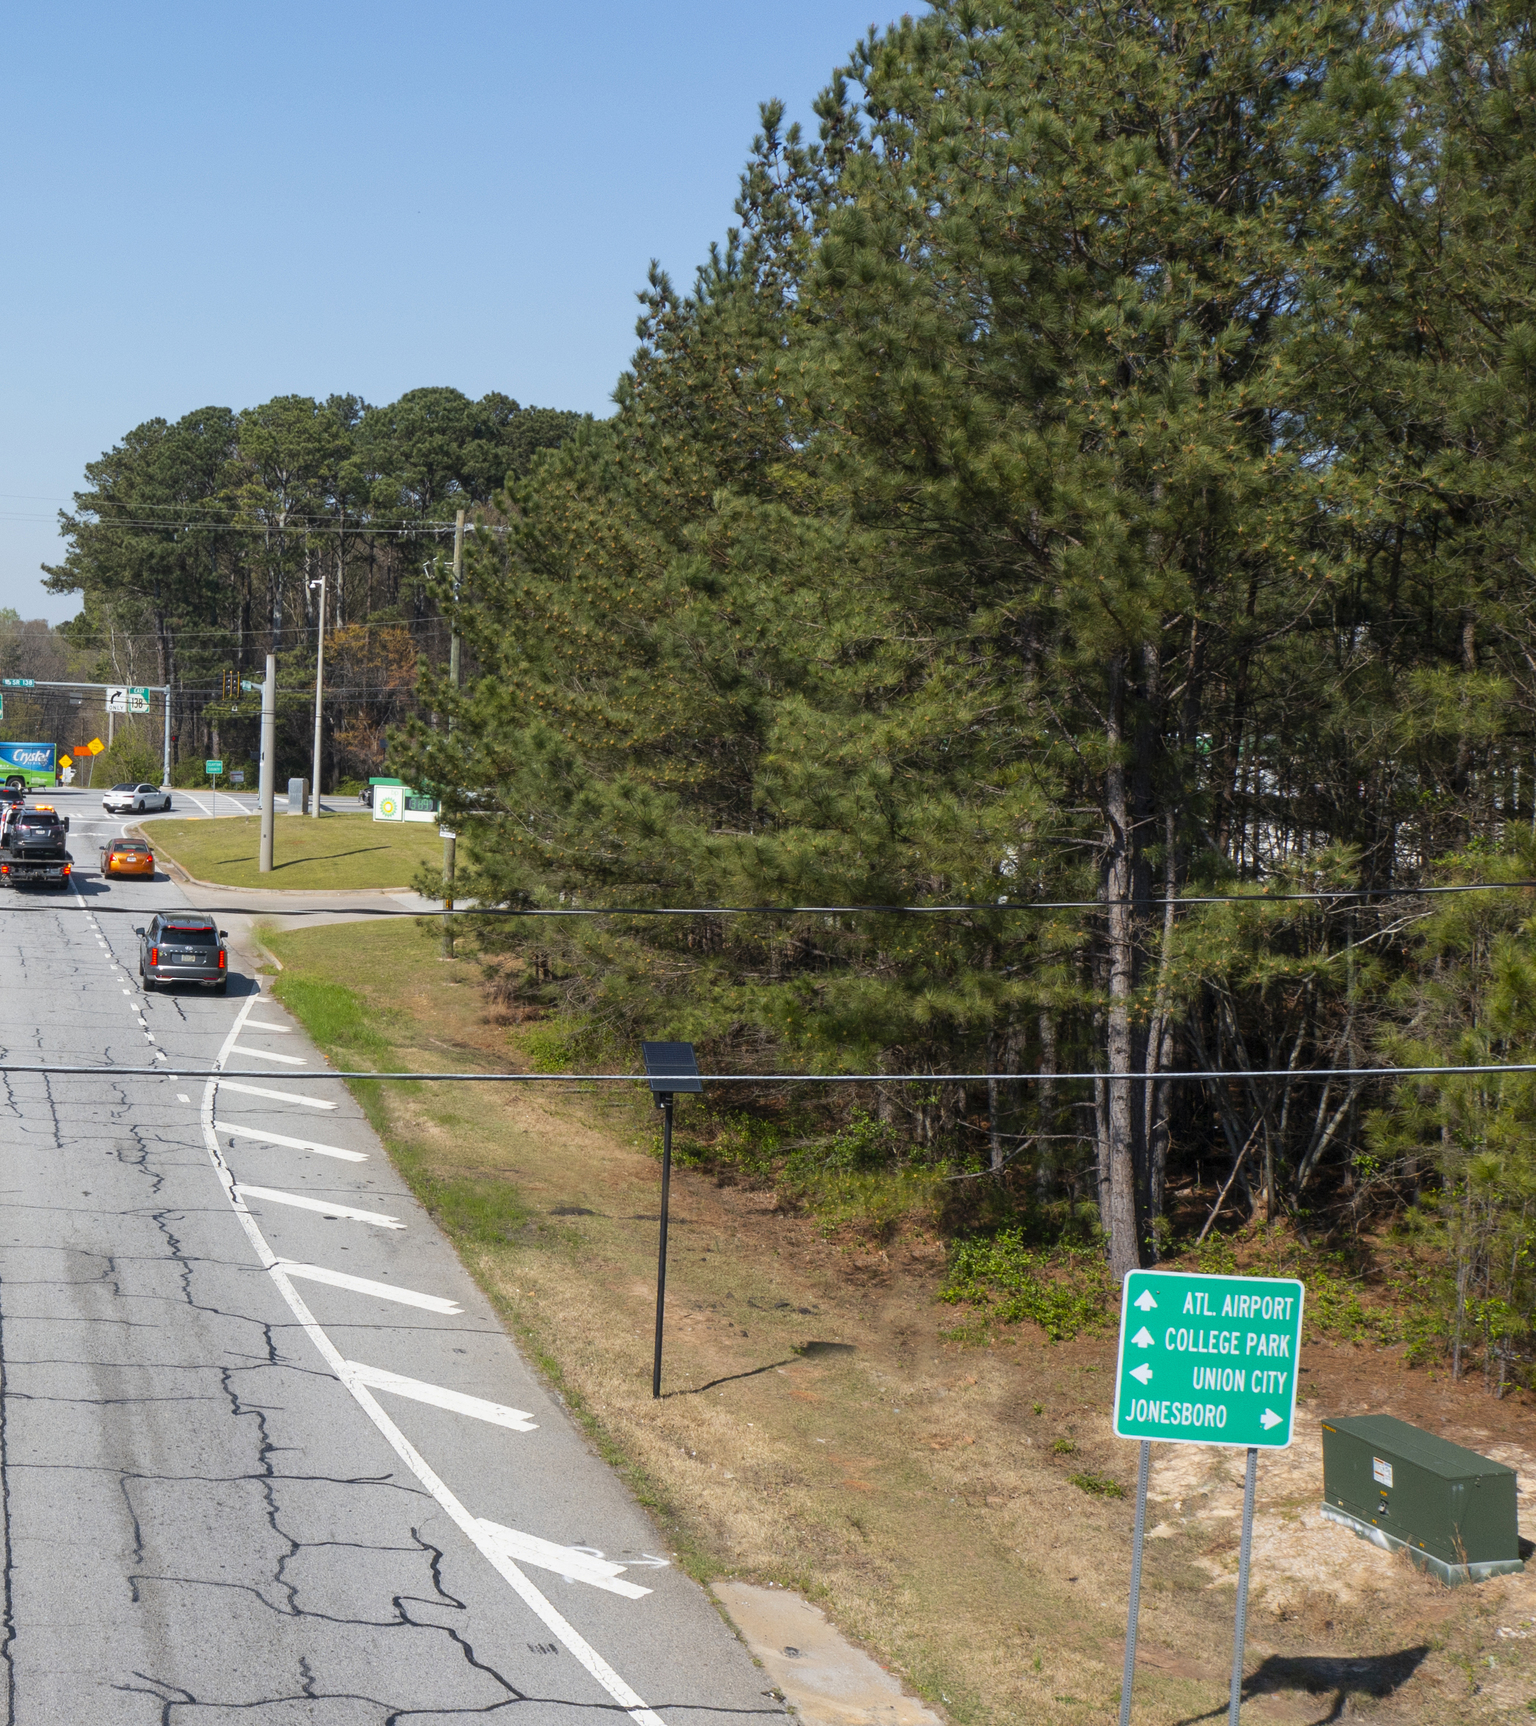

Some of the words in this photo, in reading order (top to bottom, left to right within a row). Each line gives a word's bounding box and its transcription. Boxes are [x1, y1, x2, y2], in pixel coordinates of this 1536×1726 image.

[132, 698, 143, 708] 138
[1182, 1292, 1216, 1316] ATL.
[1222, 1294, 1294, 1320] AIRPORT
[1165, 1327, 1240, 1354] COLLEGE
[1246, 1332, 1290, 1358] PARK
[1193, 1366, 1246, 1392] UNION
[1251, 1370, 1288, 1394] CITY
[1125, 1398, 1227, 1428] JONESBORO
